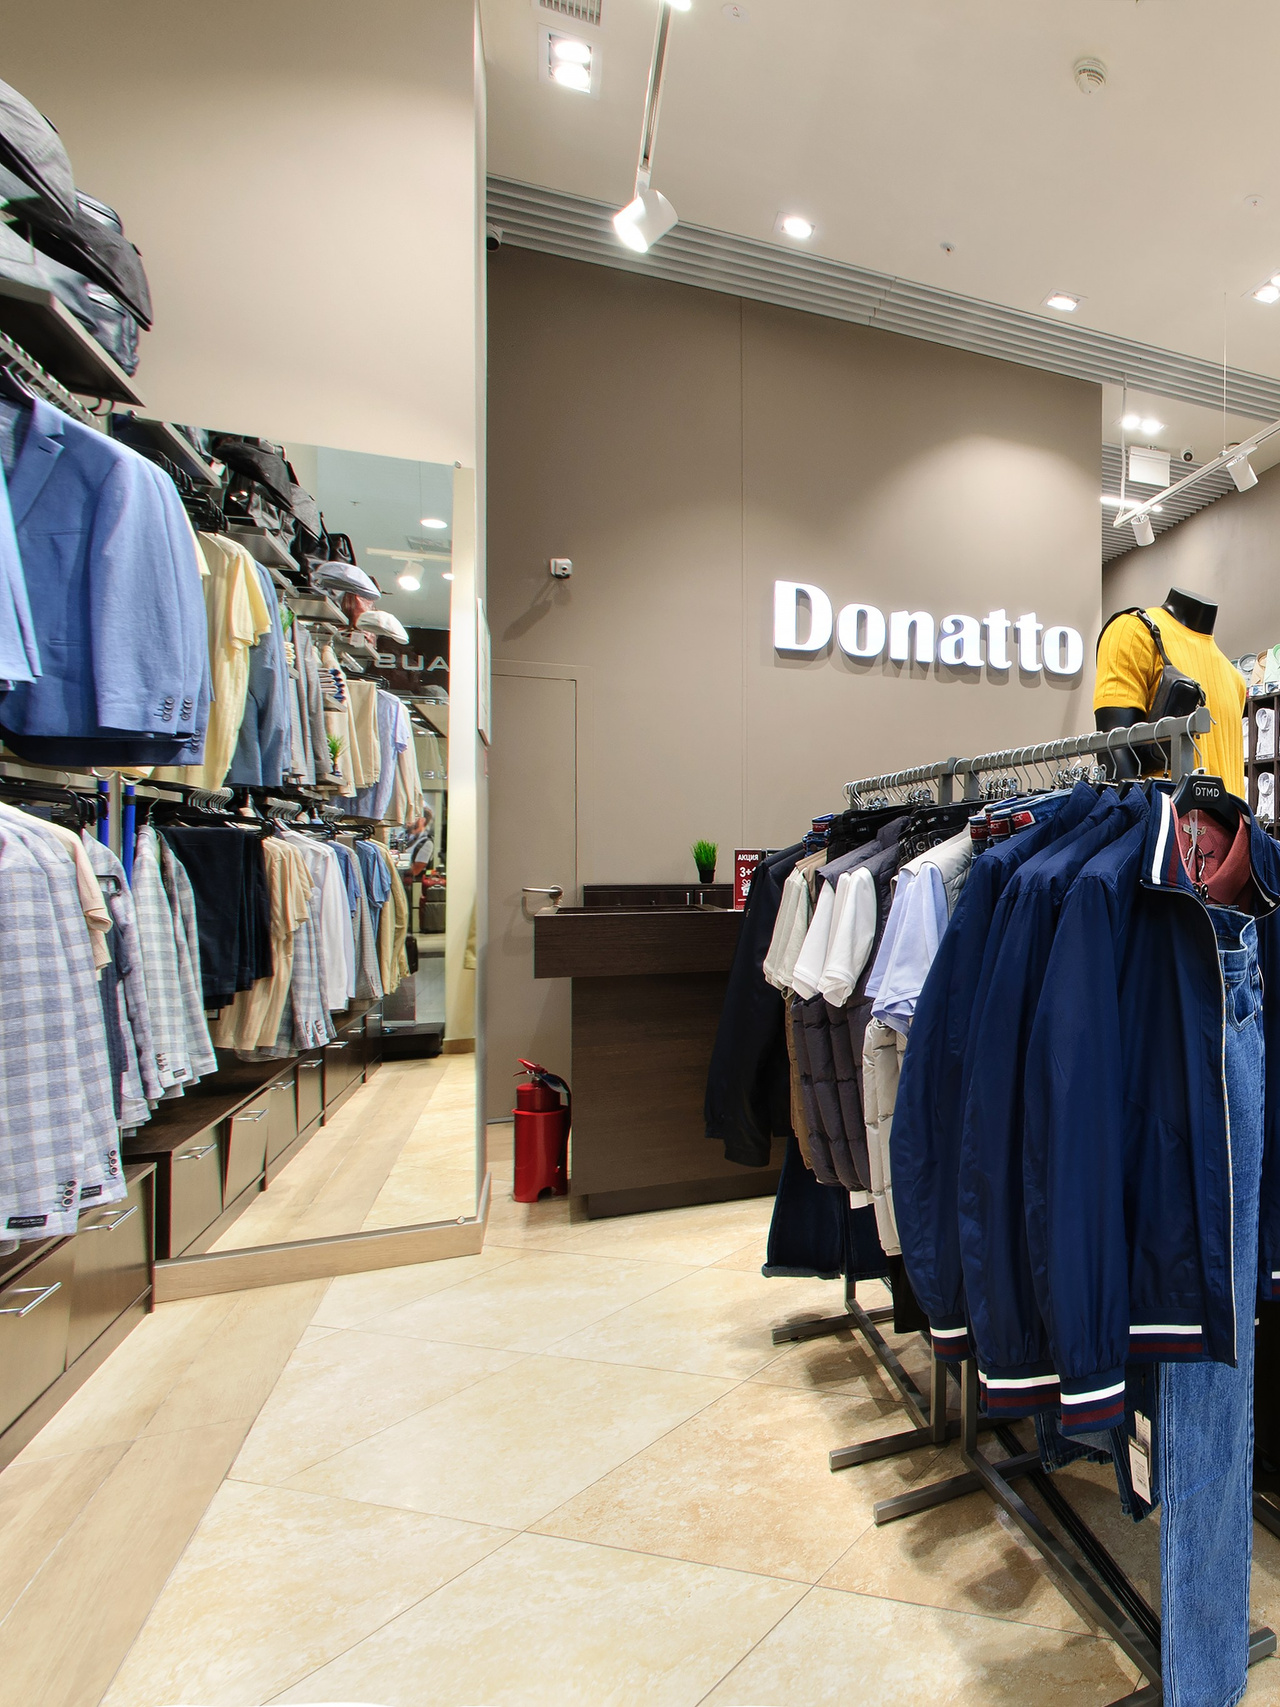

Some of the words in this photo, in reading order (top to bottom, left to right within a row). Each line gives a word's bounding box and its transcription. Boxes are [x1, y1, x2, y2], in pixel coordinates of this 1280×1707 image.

[773, 580, 1084, 675] Donatto
[1195, 787, 1220, 797] DTMD
[738, 854, 759, 862] АКЦИЯ
